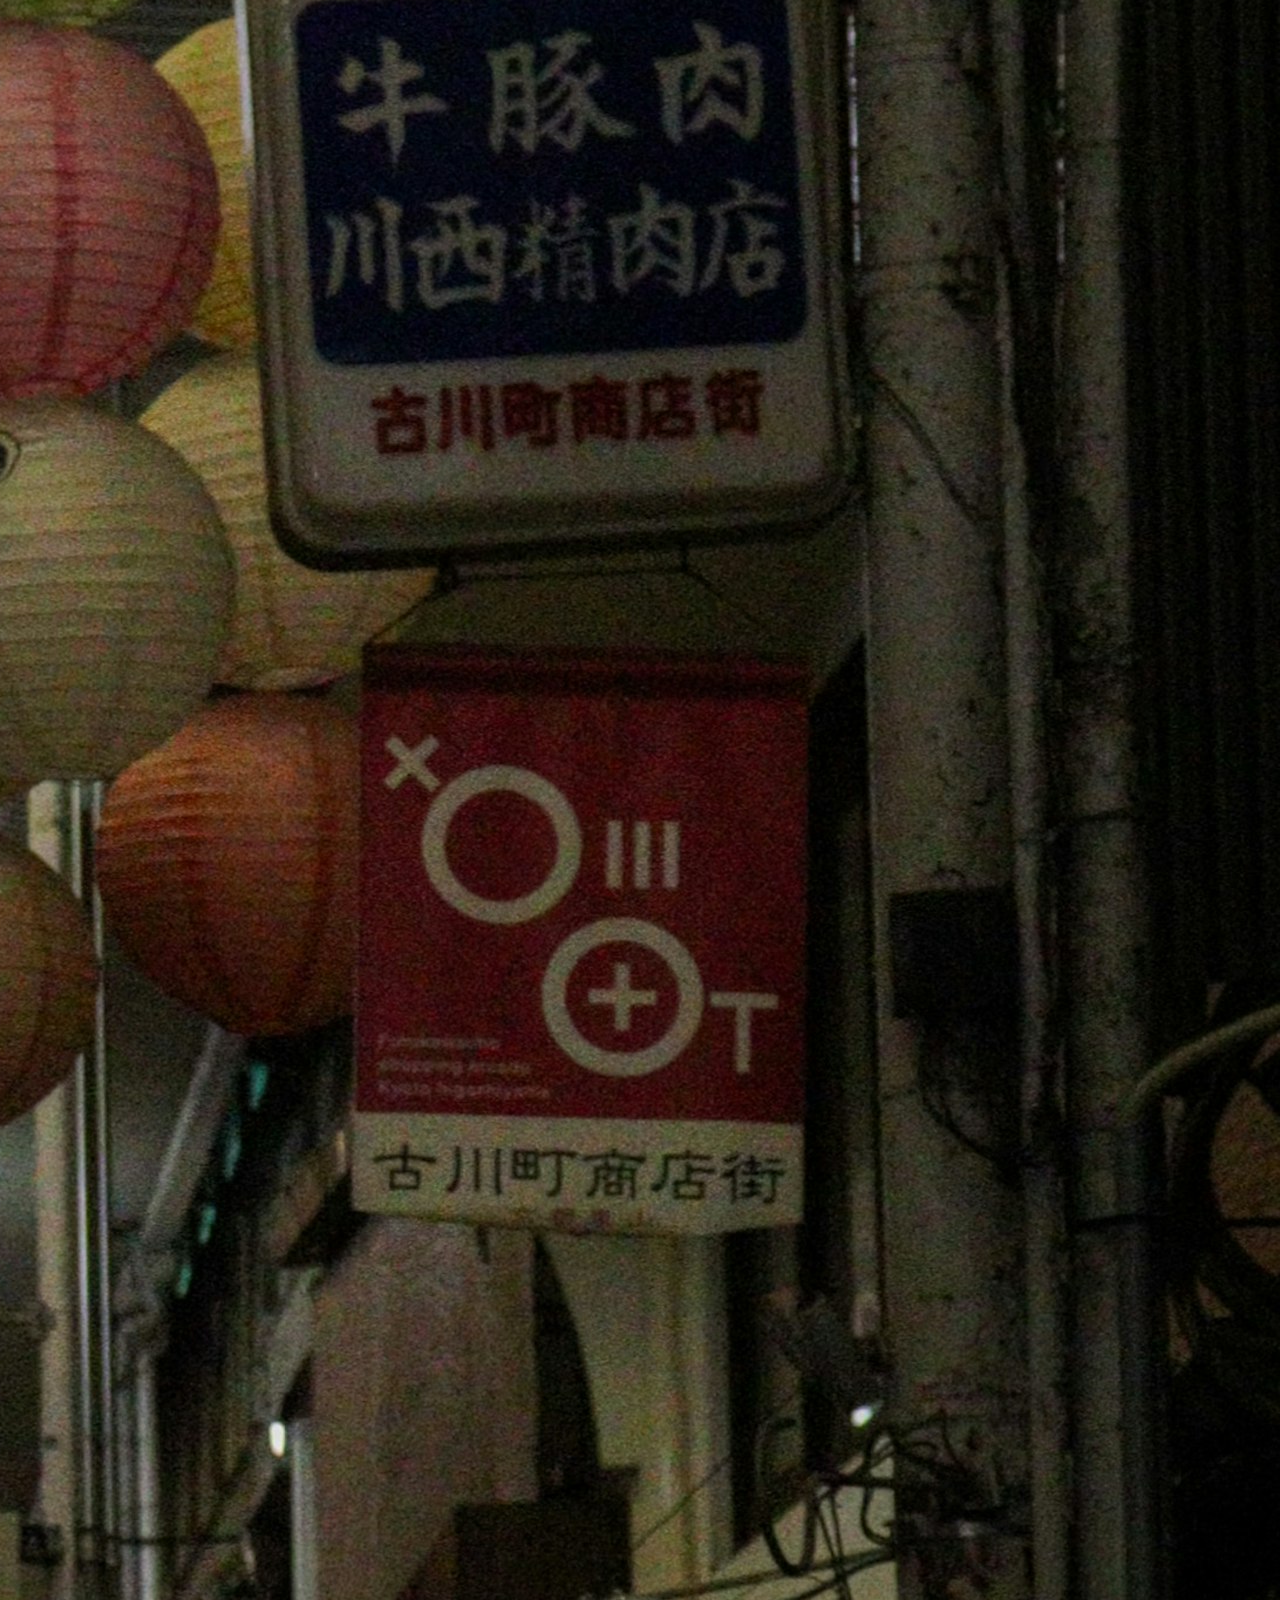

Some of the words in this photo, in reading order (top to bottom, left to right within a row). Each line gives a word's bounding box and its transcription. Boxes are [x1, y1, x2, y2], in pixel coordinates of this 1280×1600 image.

[336, 21, 768, 168] 牛豚肉
[323, 178, 788, 314] 川西精肉店
[370, 369, 766, 456] 古川町商店街
[372, 1144, 786, 1205] 古川町商店街
